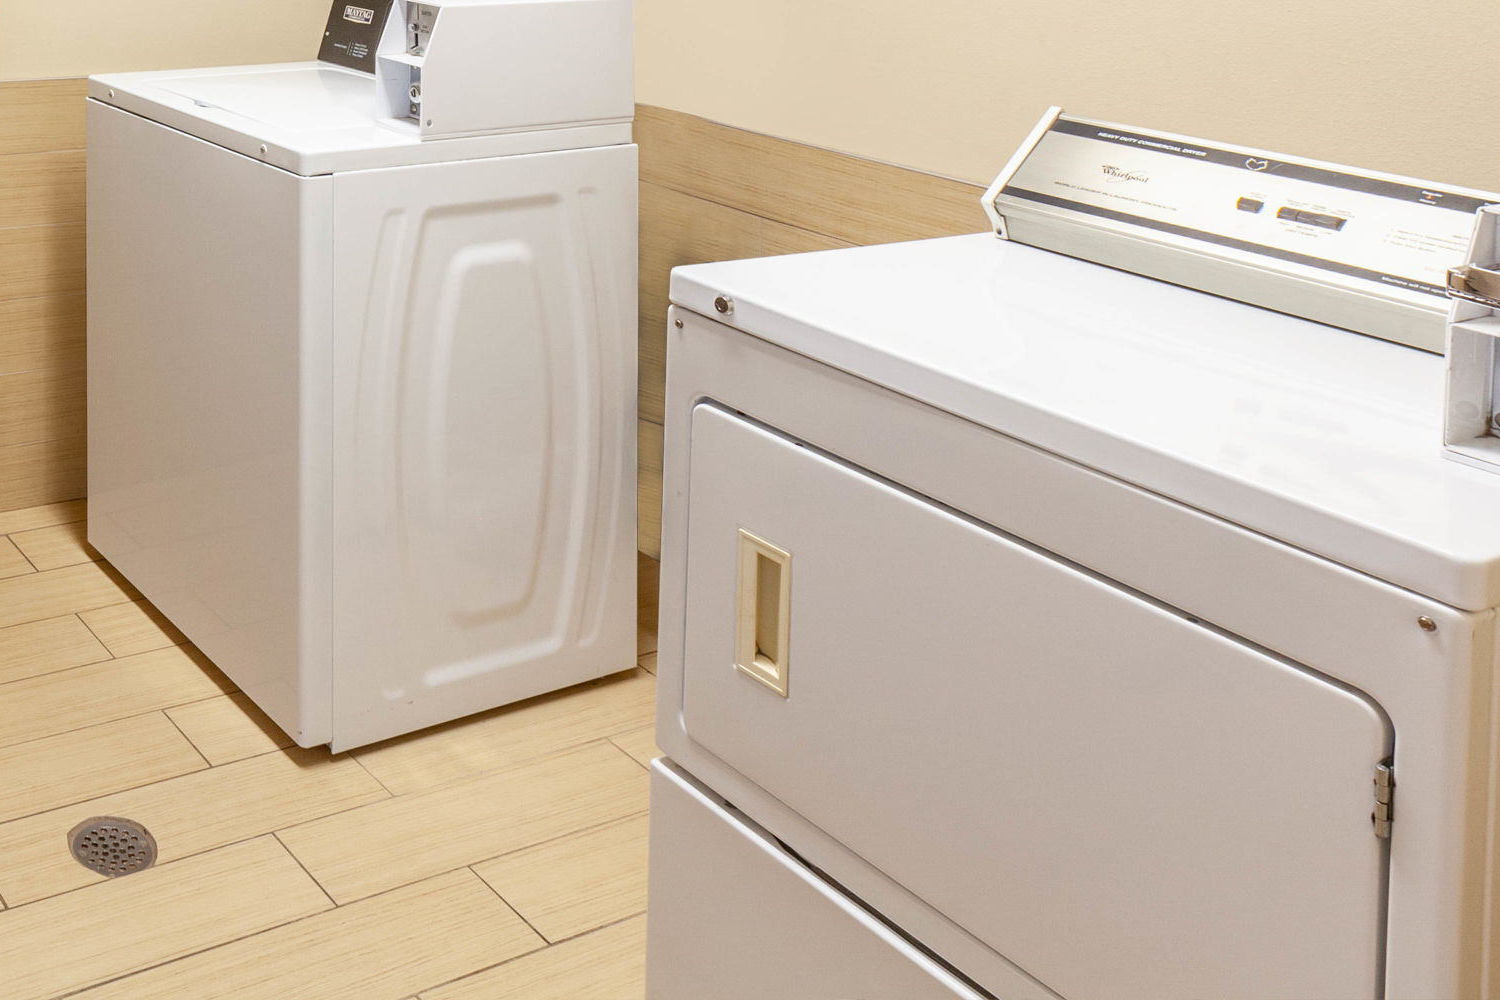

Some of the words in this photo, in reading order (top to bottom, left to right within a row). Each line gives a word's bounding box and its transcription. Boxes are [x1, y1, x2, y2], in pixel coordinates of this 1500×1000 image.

[346, 7, 372, 20] MAYTAG
[1097, 131, 1120, 140] HEAVY
[1119, 135, 1139, 143] DUTY
[1137, 139, 1182, 152] COMMERCIAL
[1182, 148, 1208, 157] DRYER
[1102, 166, 1150, 183] Whirlpool
